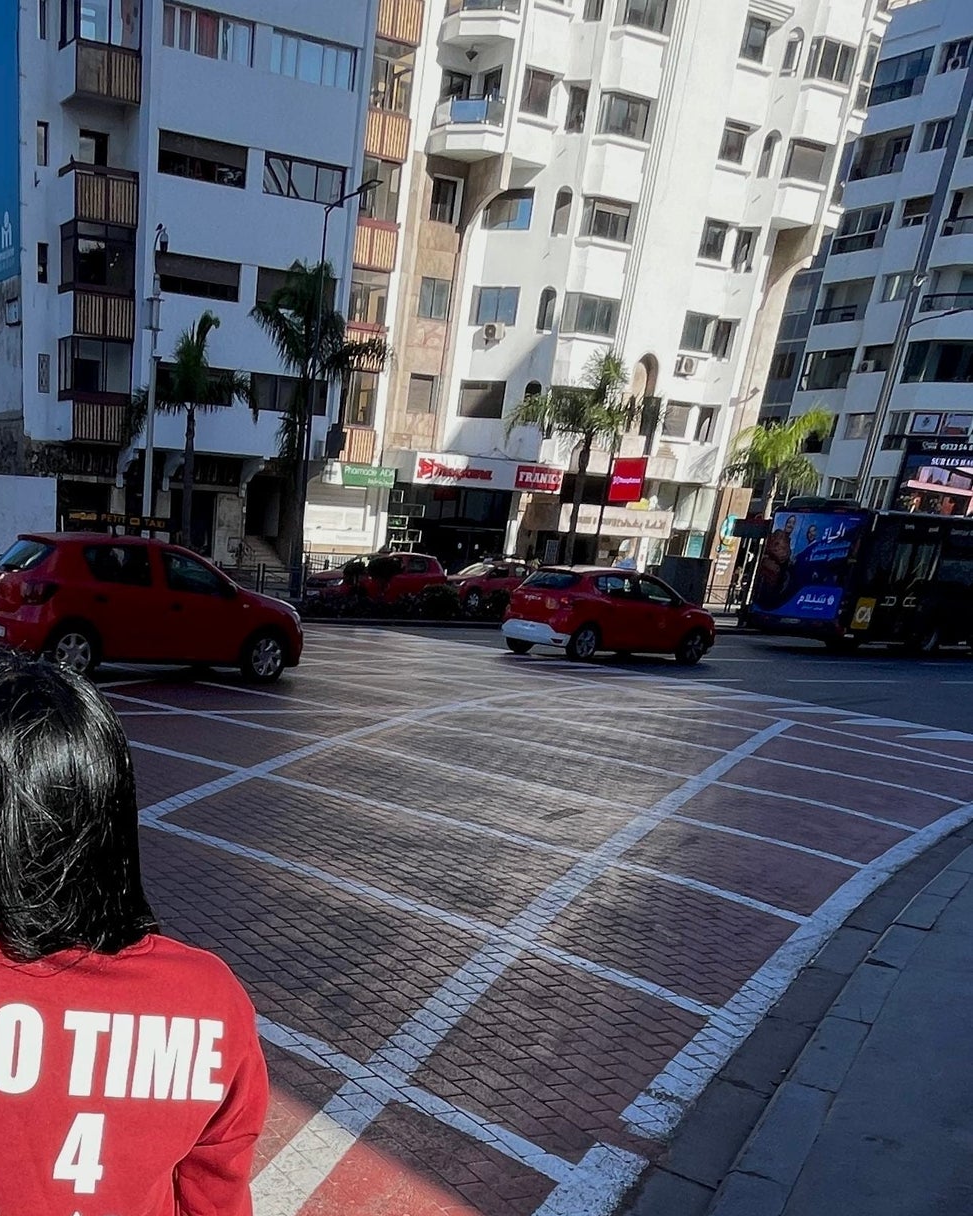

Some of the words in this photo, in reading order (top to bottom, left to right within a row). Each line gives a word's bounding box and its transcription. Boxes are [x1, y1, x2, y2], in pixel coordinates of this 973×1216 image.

[144, 518, 166, 528] TAXI
[63, 1009, 225, 1101] TIME
[52, 1112, 105, 1194] 4
